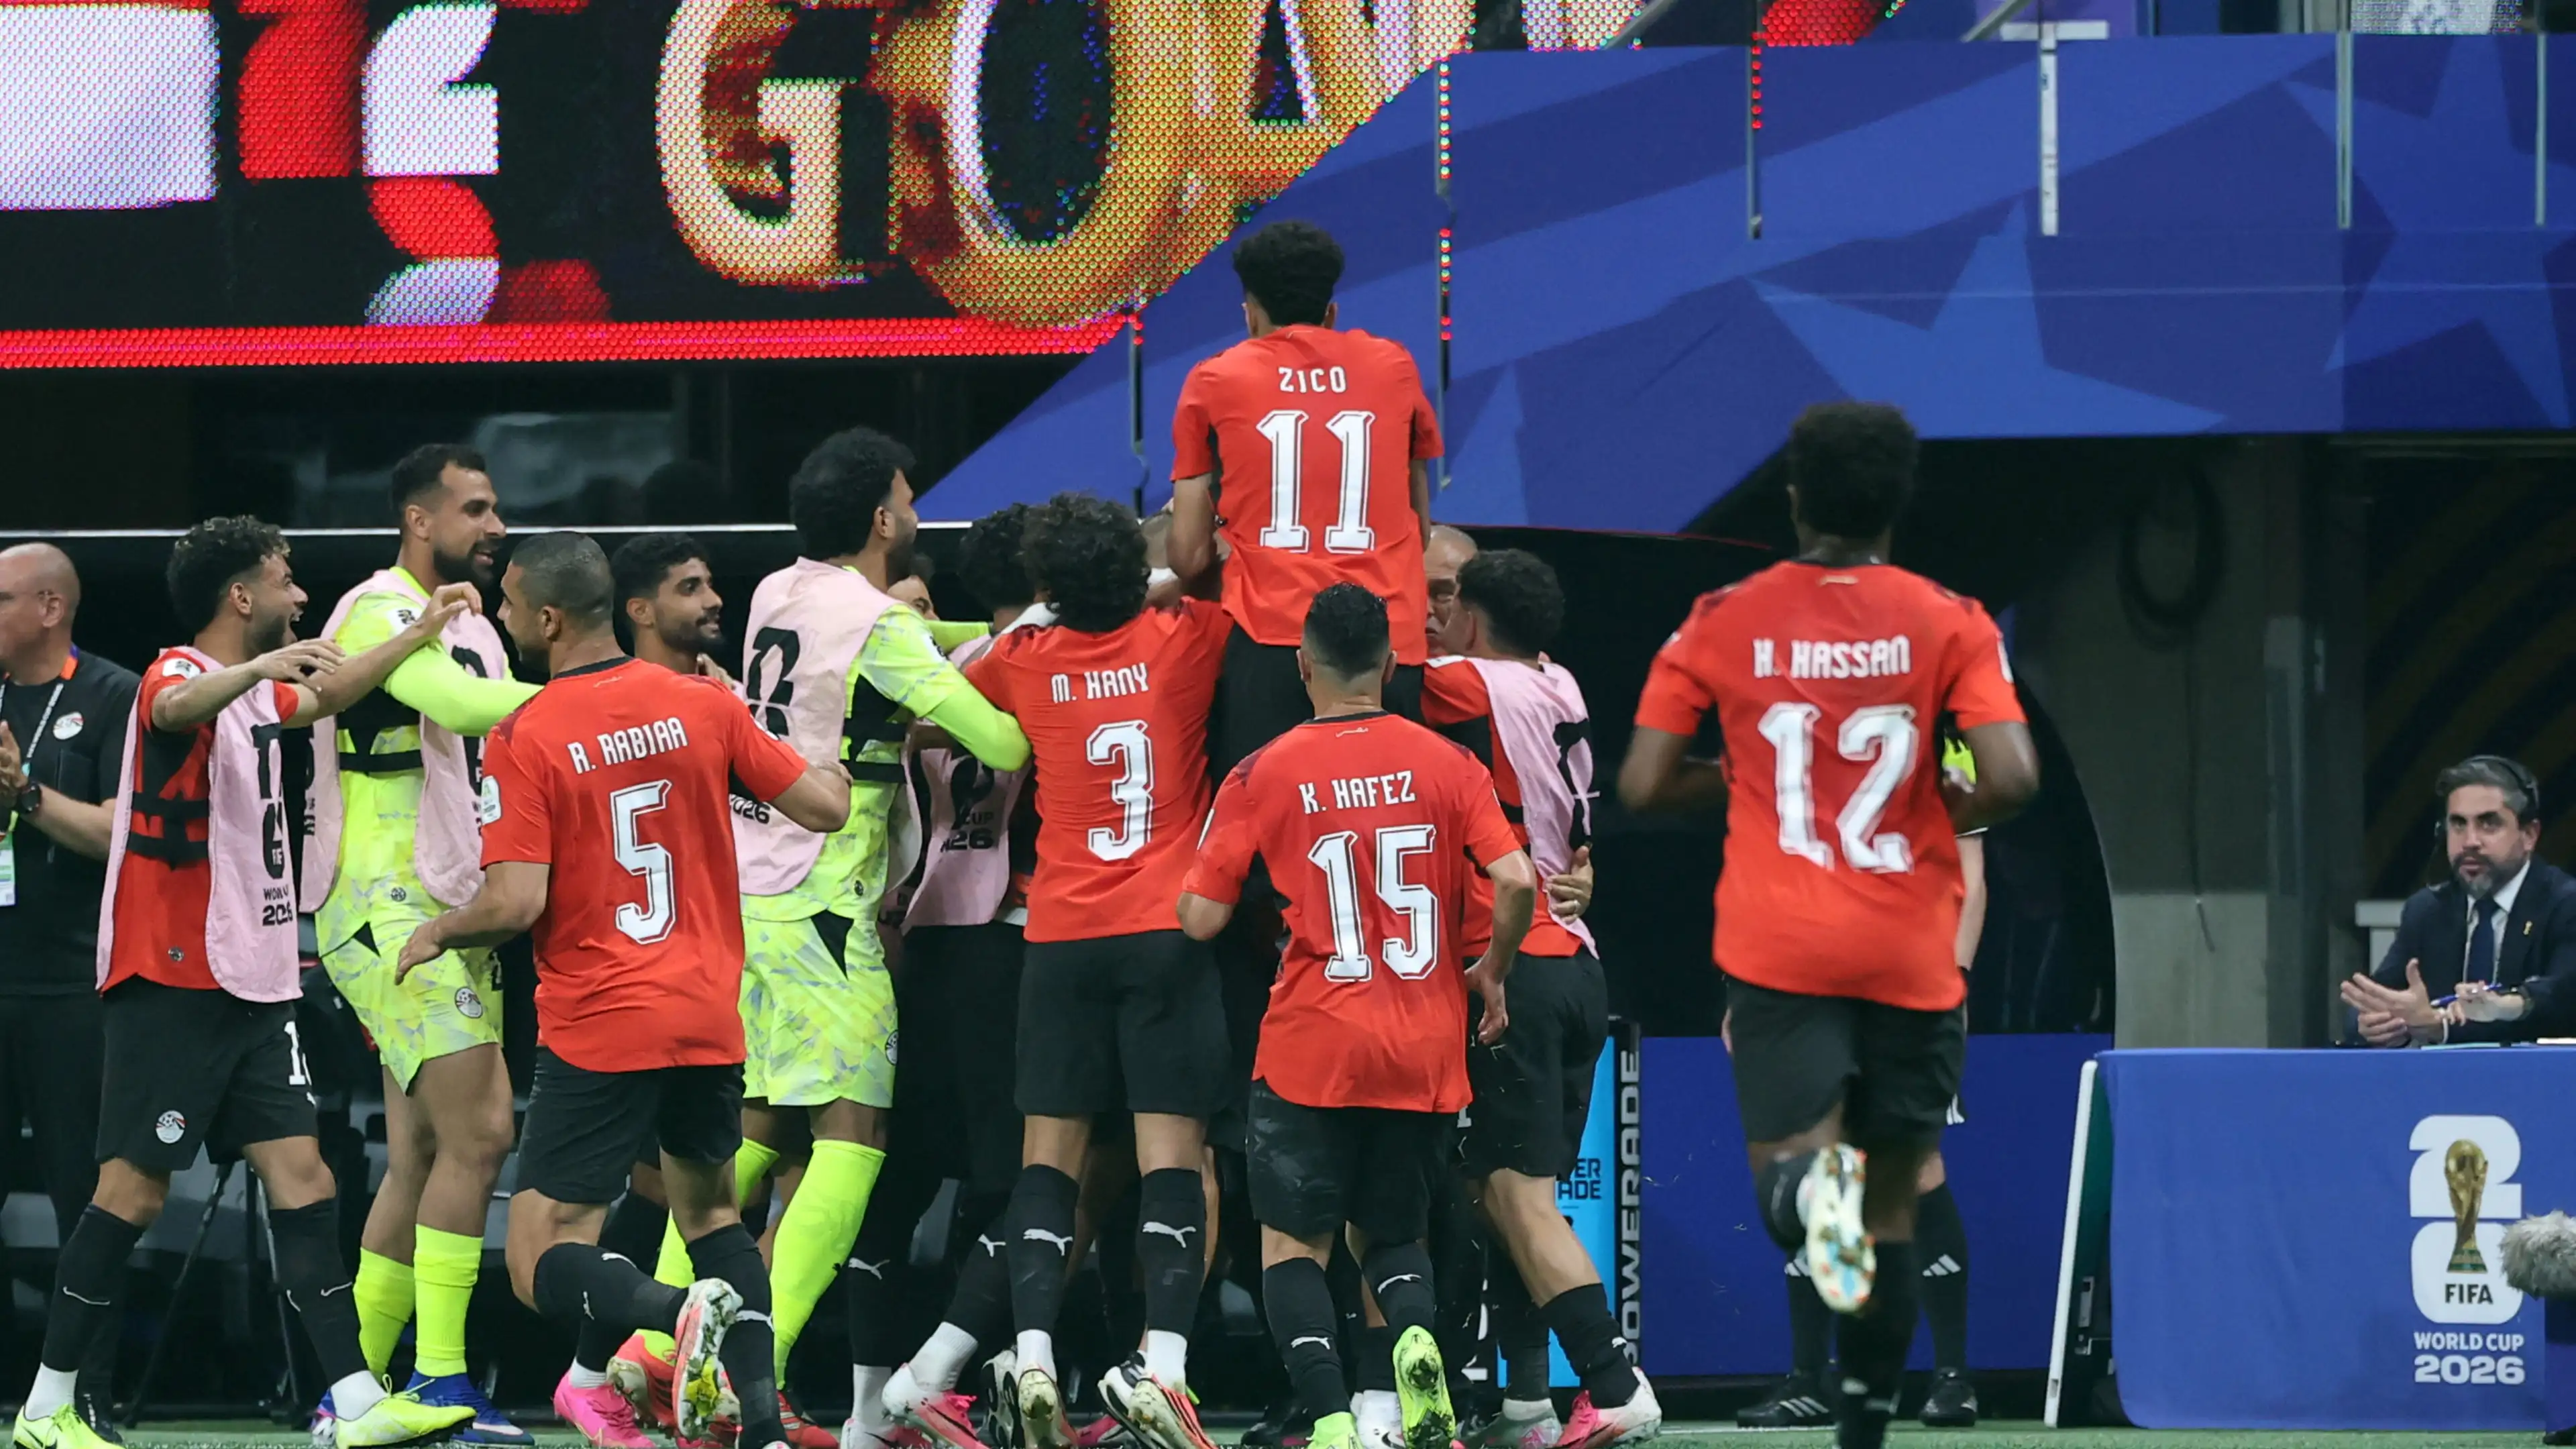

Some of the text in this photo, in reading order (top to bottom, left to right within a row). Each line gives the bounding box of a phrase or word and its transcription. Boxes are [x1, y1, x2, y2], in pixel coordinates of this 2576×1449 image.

[1278, 366, 1347, 393] ZICO
[1256, 409, 1376, 554] 11
[1752, 634, 1911, 679] H. HASSAN
[1051, 662, 1149, 704] M. HANY
[567, 717, 689, 775] R. RABIAA
[730, 794, 771, 825] 026
[1086, 720, 1155, 861] 3
[1299, 769, 1416, 814] K. HAFEZ
[1758, 701, 1920, 875] 12
[609, 778, 676, 945] 5
[1307, 824, 1438, 983] 15
[2445, 1284, 2493, 1305] FIFA
[2414, 1332, 2524, 1351] WORLD CUP
[2414, 1354, 2526, 1385] 2026
